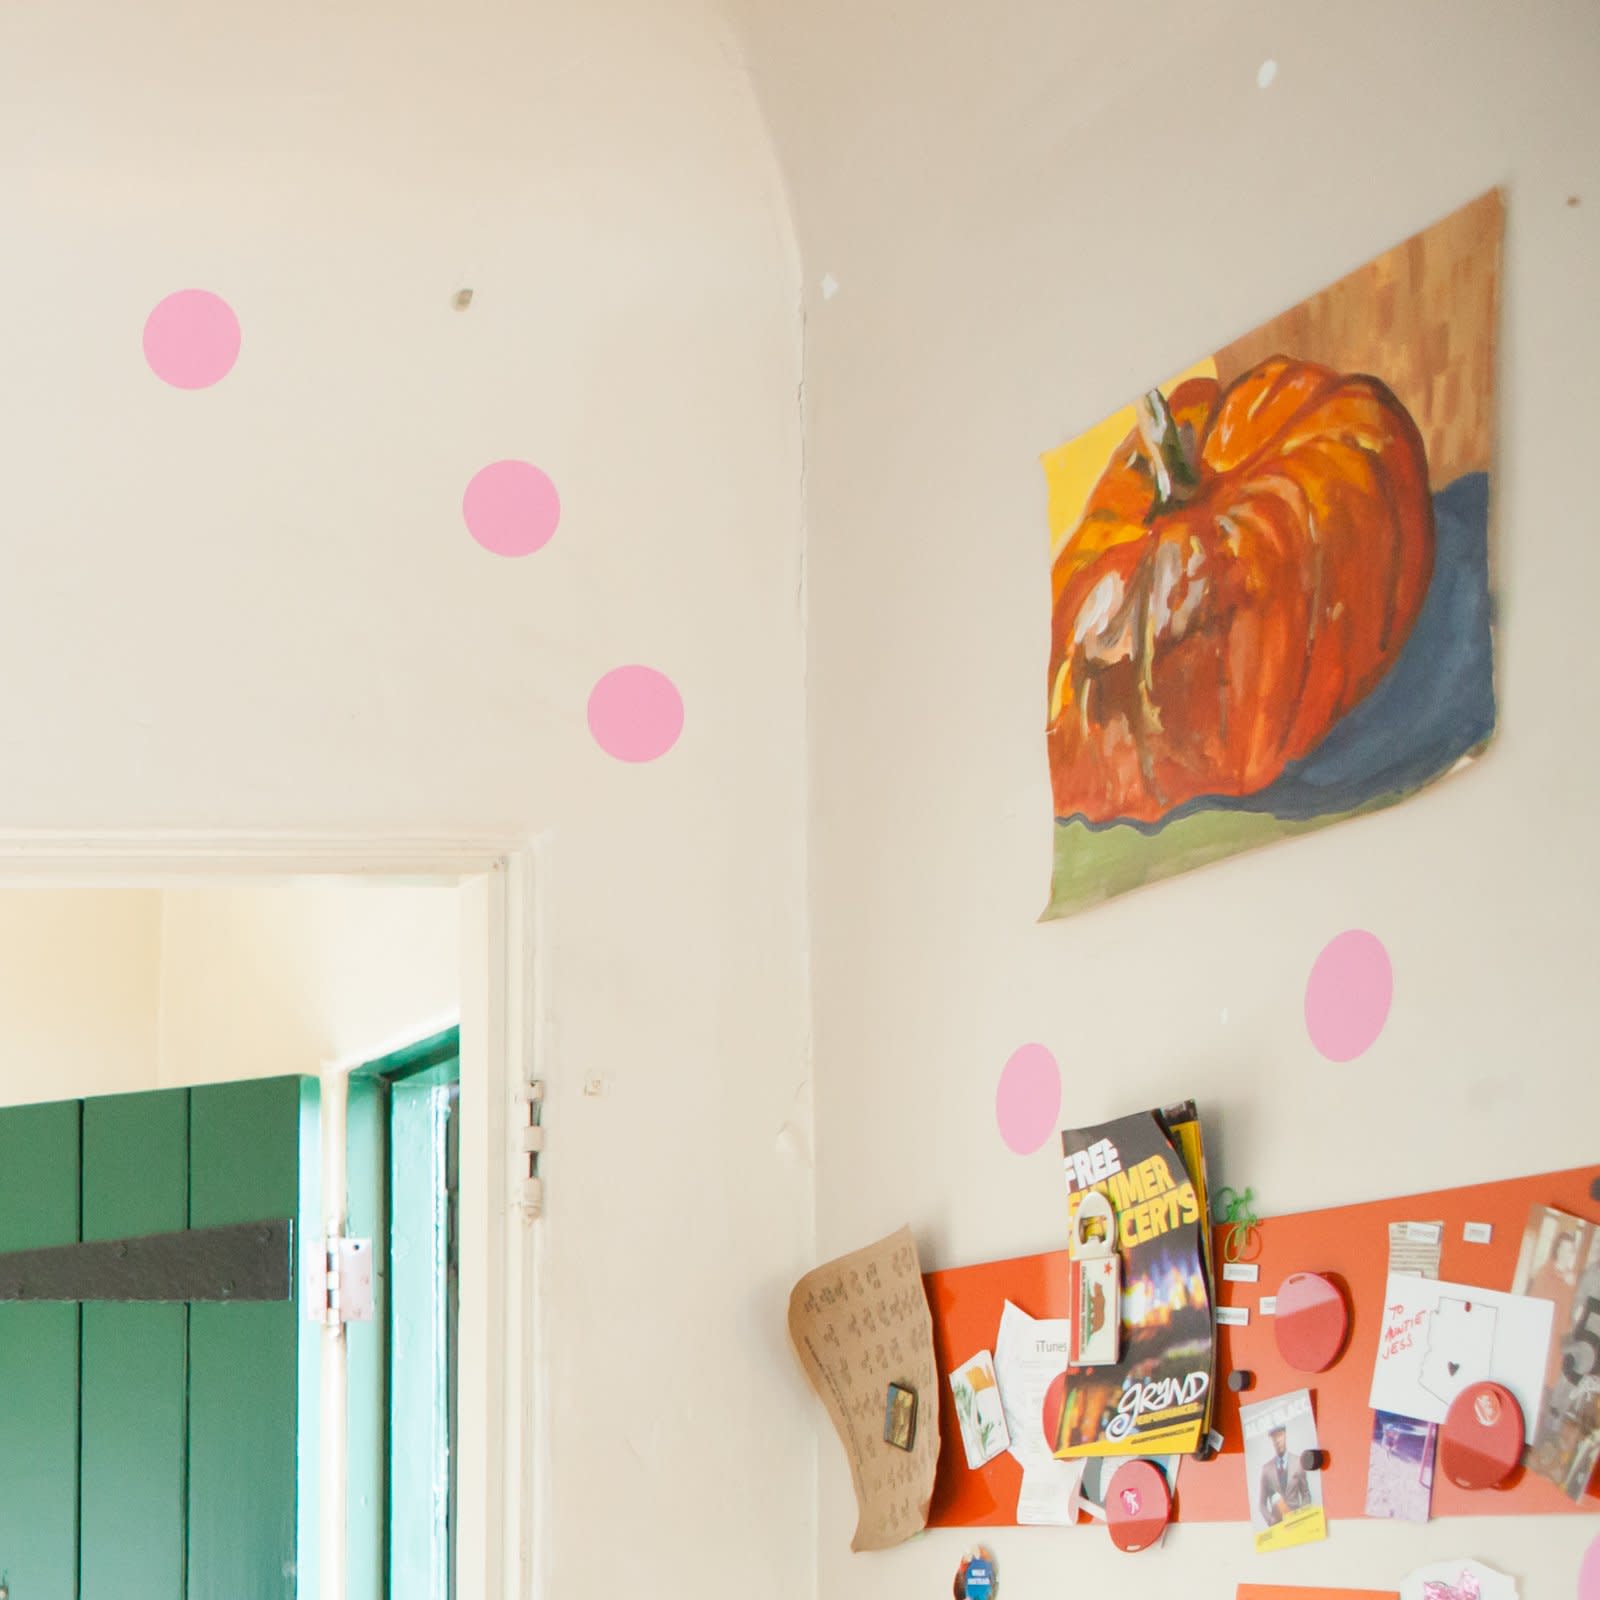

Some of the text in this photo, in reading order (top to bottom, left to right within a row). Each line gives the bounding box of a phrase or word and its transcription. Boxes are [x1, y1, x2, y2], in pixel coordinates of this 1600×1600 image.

[1063, 1138, 1121, 1194] FREE
[1068, 1155, 1177, 1217] SMMER
[1035, 1340, 1067, 1352] iTunes
